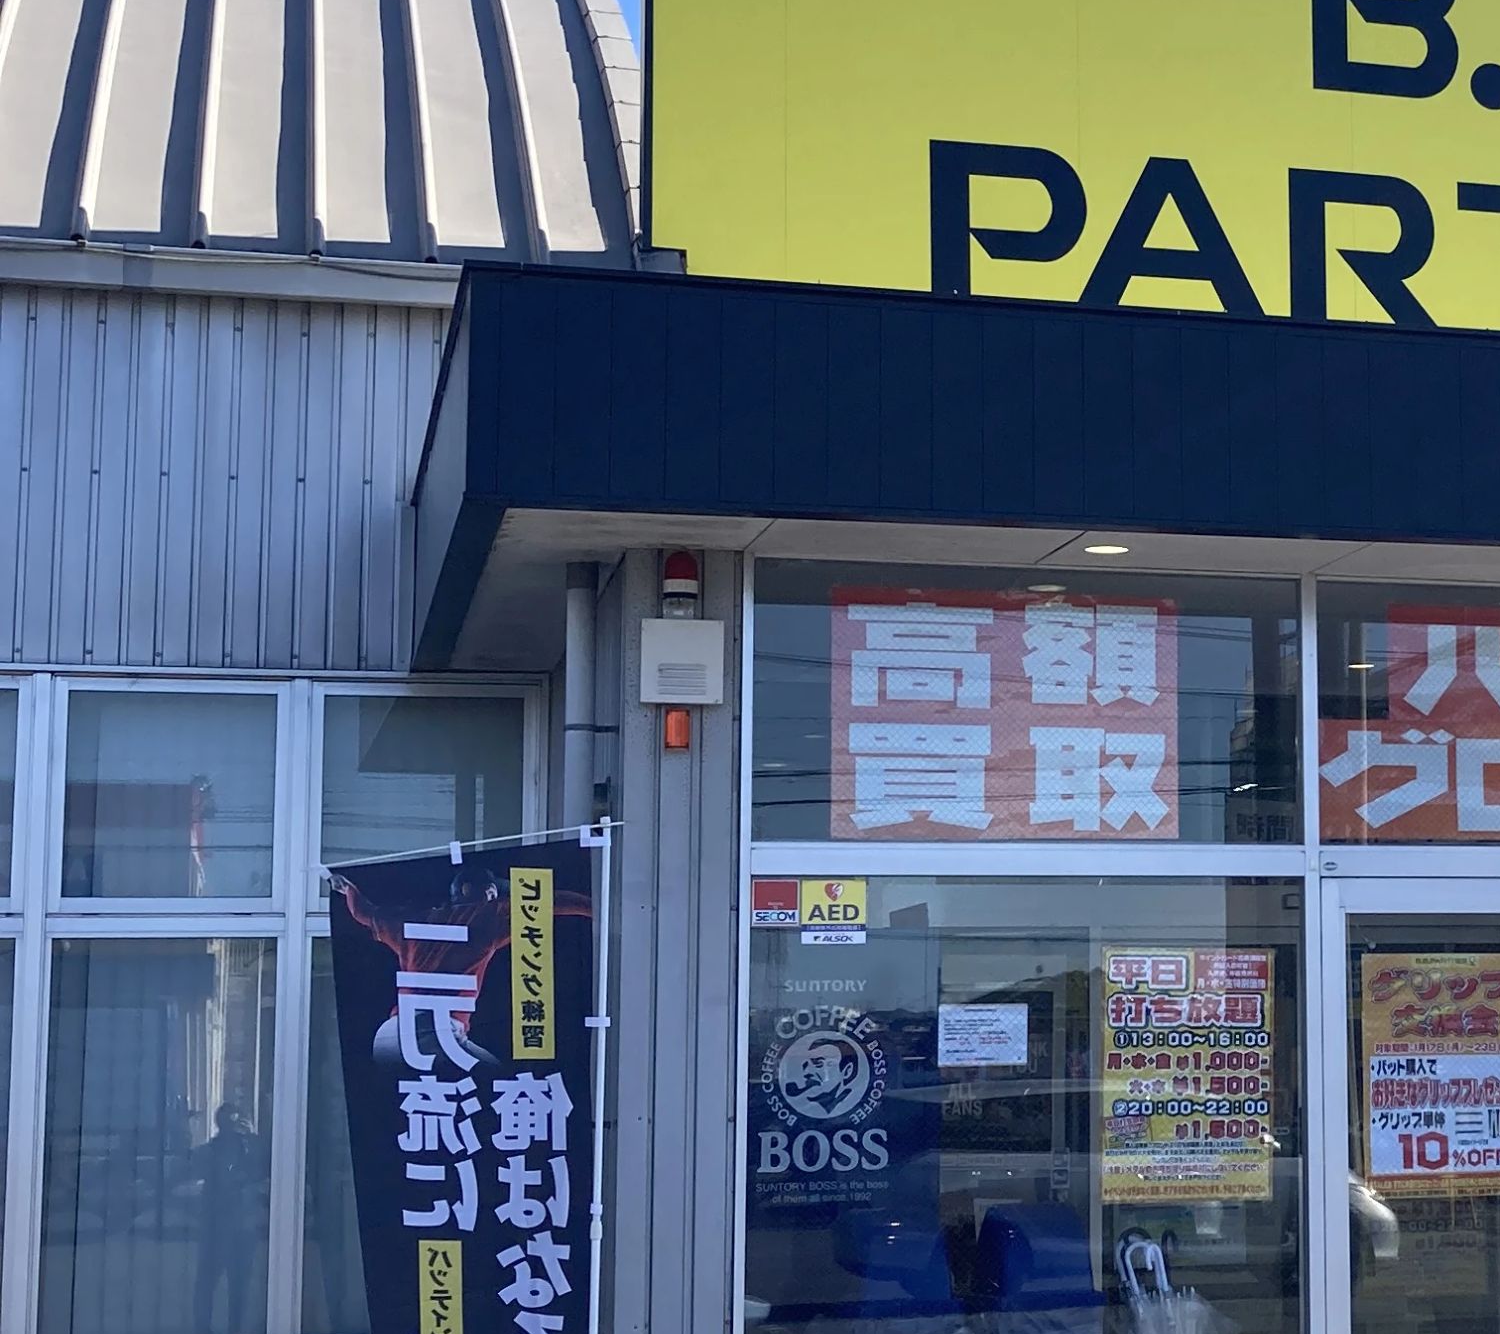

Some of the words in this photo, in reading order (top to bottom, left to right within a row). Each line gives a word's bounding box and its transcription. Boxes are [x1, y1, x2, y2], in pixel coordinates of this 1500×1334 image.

[847, 601, 1162, 709] 高額
[847, 722, 1170, 833] 買取
[755, 911, 796, 922] SECOM
[807, 904, 860, 921] AED
[783, 978, 868, 993] SUNTORY
[1109, 955, 1187, 990] 平日
[775, 1004, 877, 1040] COFFEE
[1109, 992, 1263, 1029] 打ち放題
[761, 1041, 783, 1093] COFFEE
[866, 1039, 887, 1075] BOSS
[767, 1095, 798, 1127] BOSS
[848, 1079, 886, 1126] COFFEE
[756, 1127, 889, 1173] BOSS
